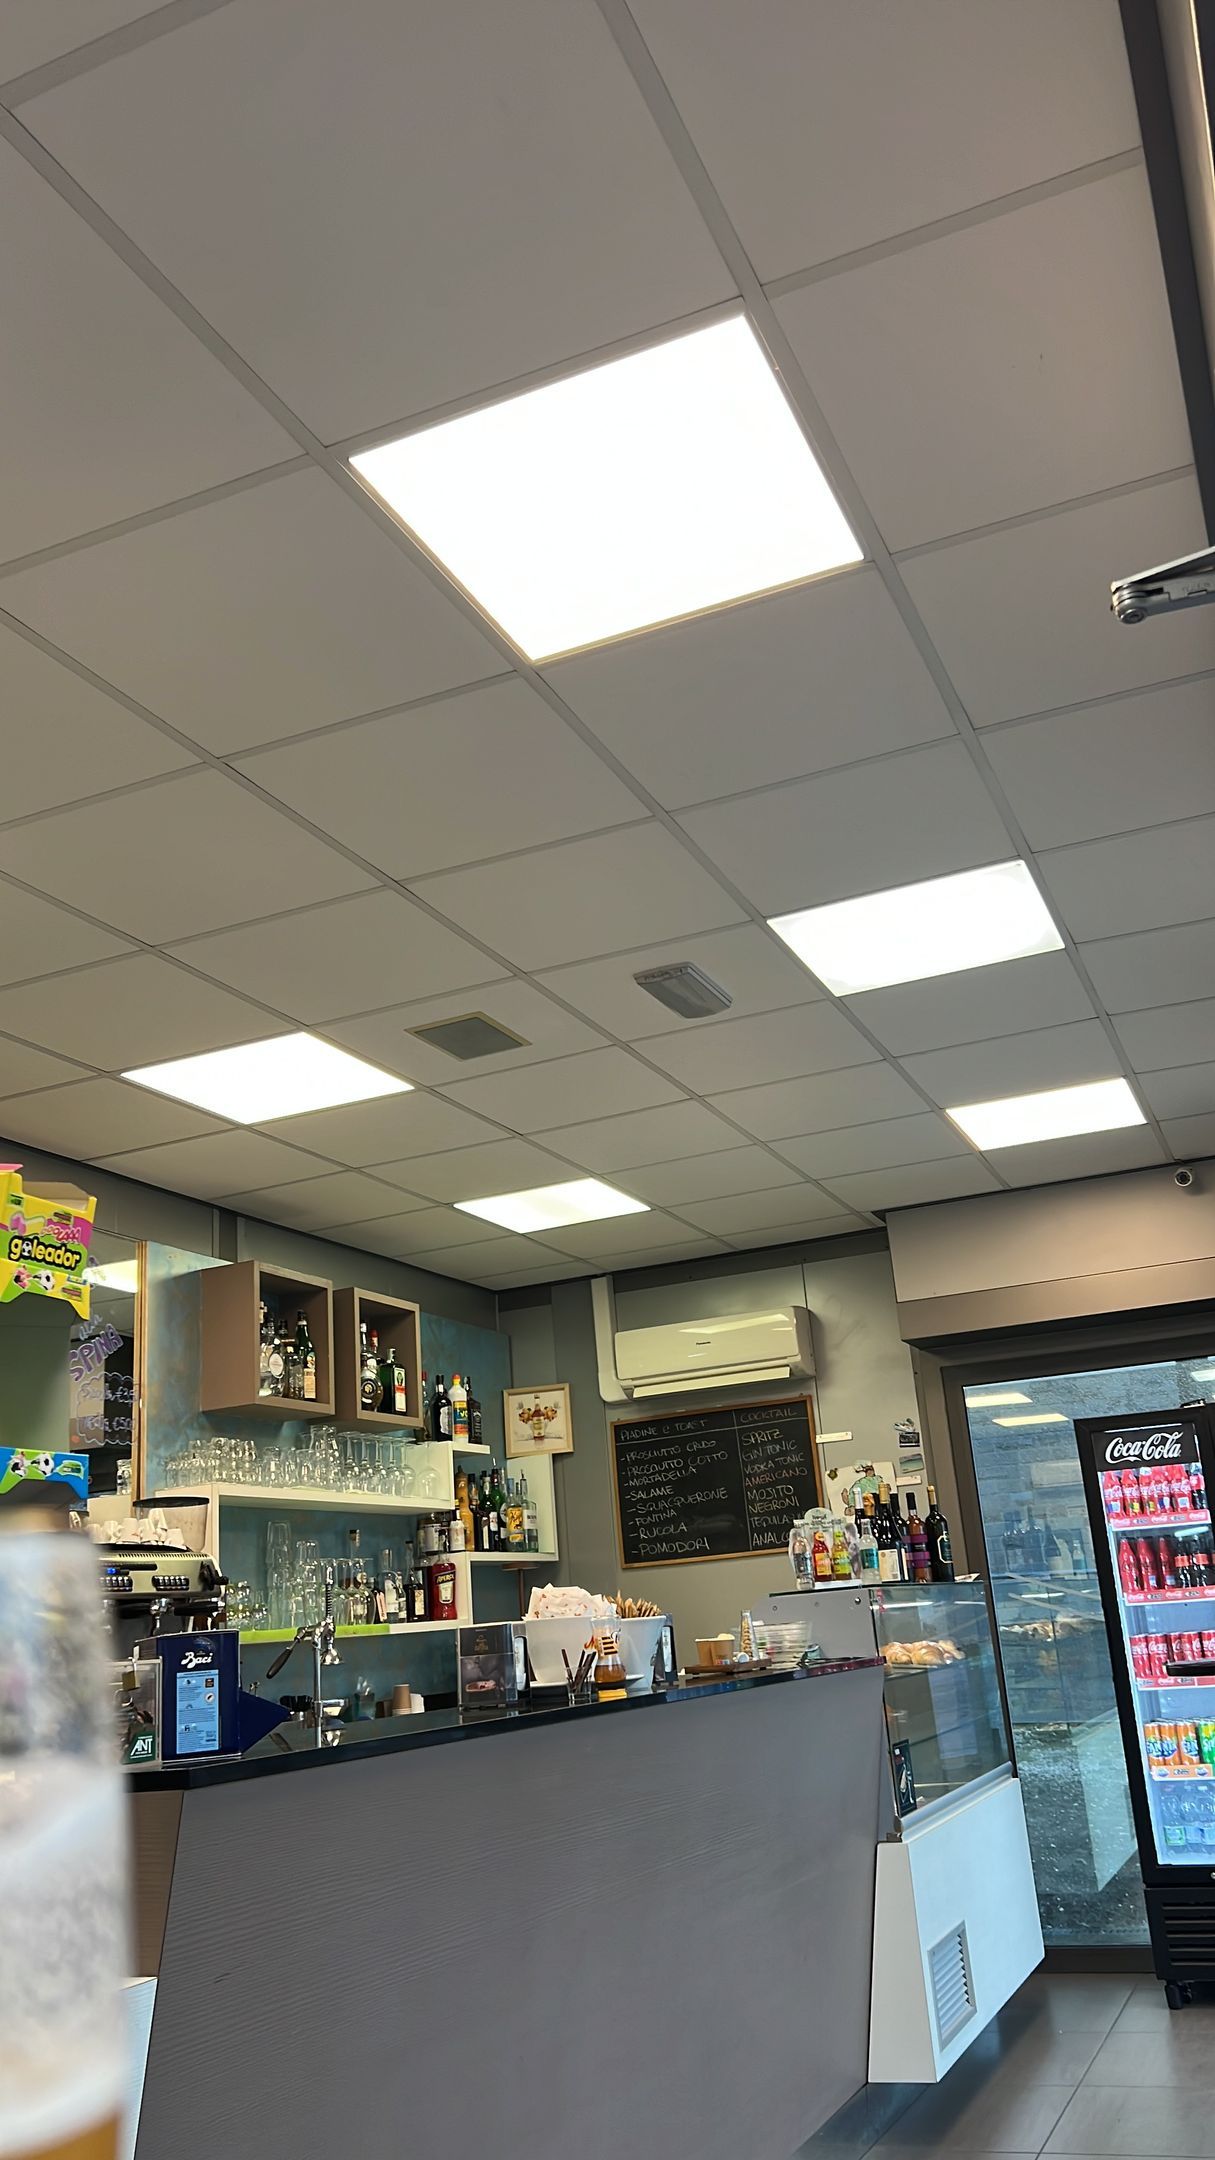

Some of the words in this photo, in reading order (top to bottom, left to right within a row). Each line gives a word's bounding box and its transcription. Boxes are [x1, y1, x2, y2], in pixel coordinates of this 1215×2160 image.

[9, 1236, 81, 1270] goleador
[69, 1323, 124, 1381] SPINA
[741, 1408, 798, 1423] COCKTAIL
[741, 1428, 784, 1445] SPRITZ
[686, 1440, 716, 1452] CRUDO
[742, 1446, 763, 1461] GIN
[764, 1440, 797, 1455] TONIC
[1105, 1431, 1184, 1464] Coca-Cola
[688, 1451, 728, 1466] COTTO
[744, 1460, 775, 1474] VODKA
[775, 1452, 806, 1465] TONIC
[745, 1467, 808, 1487] AMERICANO
[747, 1485, 794, 1500] MOJITO
[748, 1495, 800, 1513] NEGRONI
[750, 1514, 789, 1528] TEQUILA
[181, 1651, 213, 1669] Baci
[130, 1738, 153, 1756] ANT
